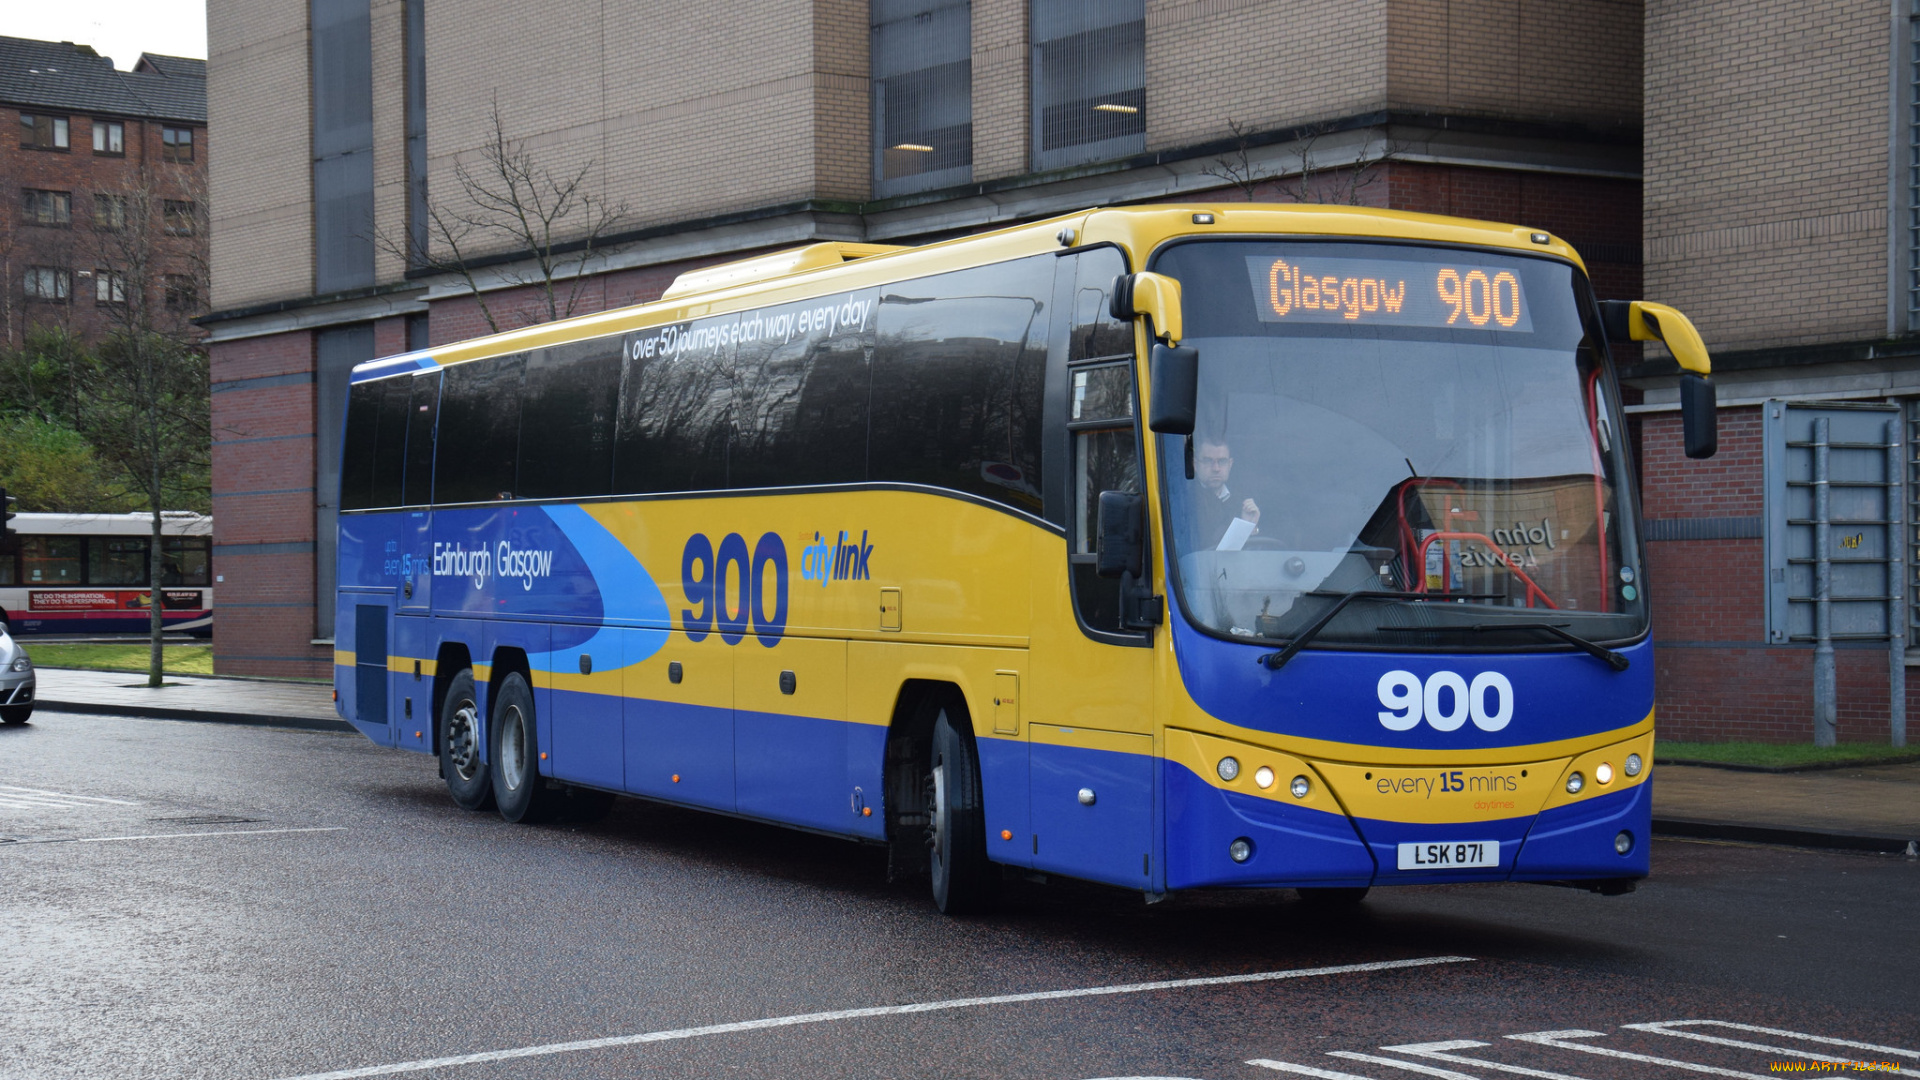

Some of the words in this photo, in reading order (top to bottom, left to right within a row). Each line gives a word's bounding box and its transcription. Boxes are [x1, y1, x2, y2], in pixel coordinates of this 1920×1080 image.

[1269, 259, 1405, 320] Glasgow
[1437, 268, 1520, 327] 900
[632, 337, 658, 361] over
[658, 327, 678, 356] 50
[674, 320, 730, 362] journeys
[730, 311, 762, 344] each
[798, 304, 842, 338] every
[840, 293, 872, 333] day
[402, 553, 412, 576] 15
[433, 541, 492, 590] Edinburgh
[497, 540, 553, 591] Glasgow
[801, 529, 874, 588] citylink
[681, 531, 789, 649] 900
[1376, 669, 1515, 732] 900
[1376, 777, 1436, 799] every
[1439, 771, 1465, 792] 15
[1469, 770, 1517, 792] mins
[1473, 800, 1515, 812] daytimes
[1415, 844, 1450, 865] LSK
[1455, 843, 1483, 864] 871
